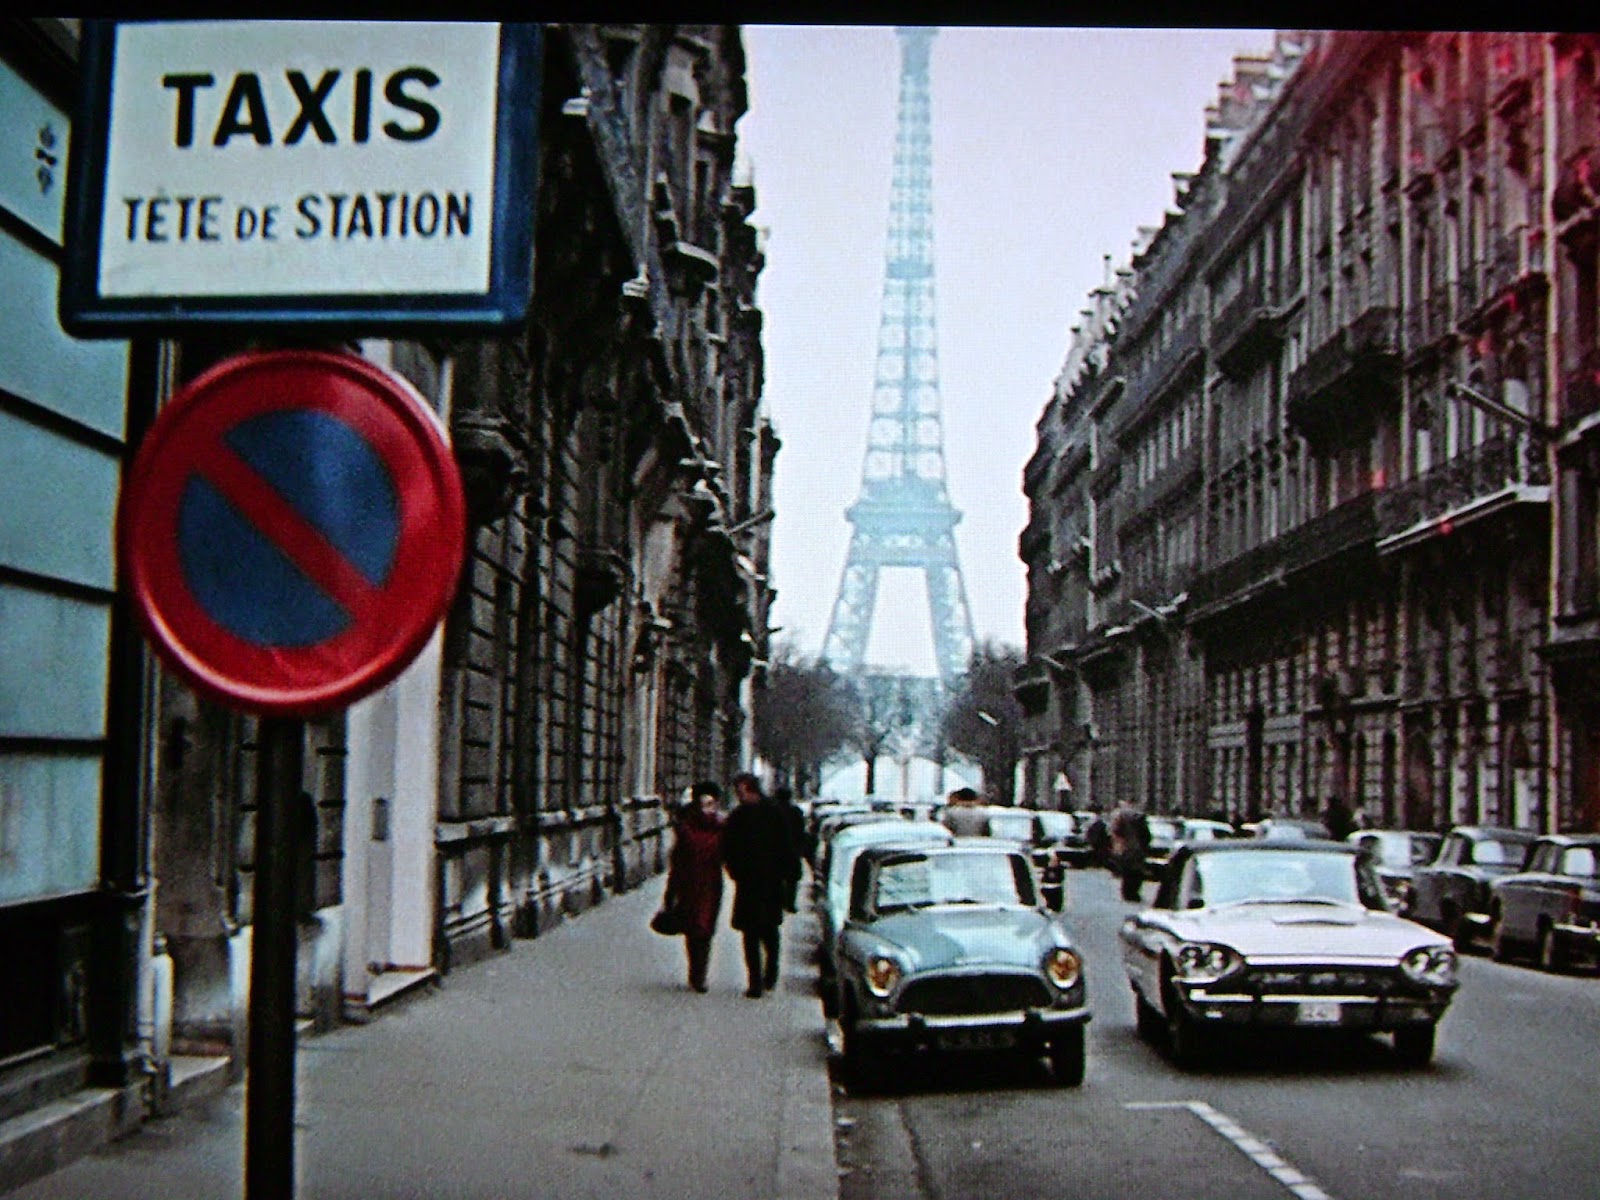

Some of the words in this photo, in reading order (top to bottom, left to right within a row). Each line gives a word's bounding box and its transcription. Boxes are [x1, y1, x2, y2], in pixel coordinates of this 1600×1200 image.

[162, 66, 442, 149] TAXIS
[235, 205, 279, 242] DE
[295, 191, 472, 240] STATION
